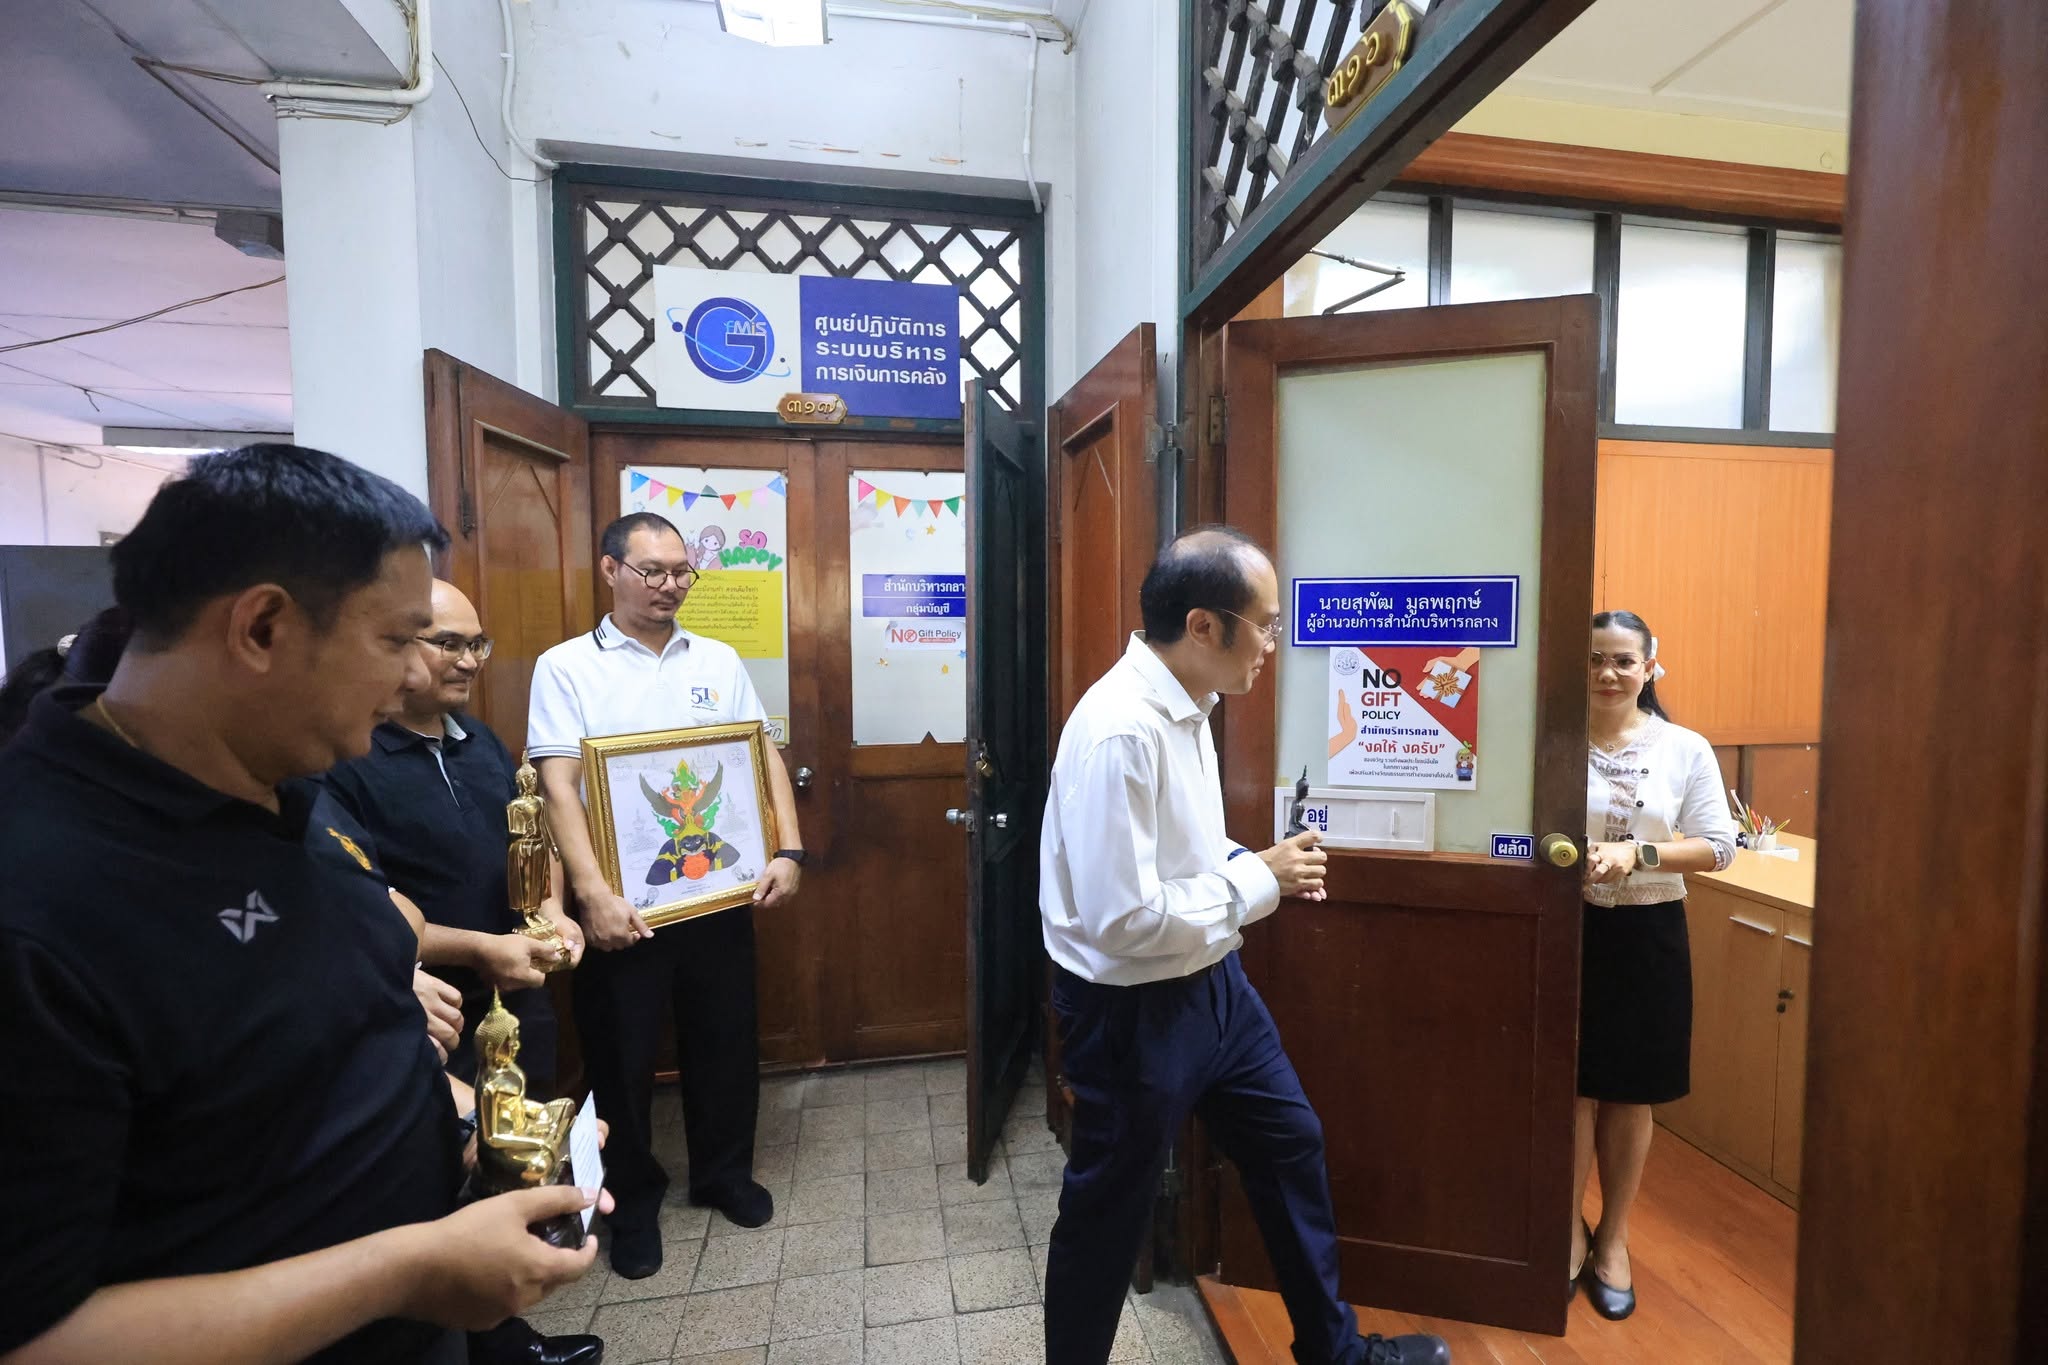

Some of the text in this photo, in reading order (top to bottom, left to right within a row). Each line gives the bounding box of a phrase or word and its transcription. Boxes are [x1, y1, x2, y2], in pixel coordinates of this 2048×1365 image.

[815, 313, 946, 337] ศูนย์ปฏิบัติการ
[816, 341, 946, 361] ระบบบริหาร
[816, 364, 947, 385] การเงินการคลัง
[787, 399, 837, 414] ๓๑๗
[739, 529, 767, 549] SO
[718, 546, 783, 571] HAPPY
[884, 578, 966, 592] สำนักบริหารกลา
[906, 602, 950, 616] กลุ่มบัญชี
[1319, 589, 1482, 615] นายสุพัฒ มูลพฤกษ์
[1306, 613, 1498, 633] ผู้อำนวยการสำนักบริหารกลาง
[918, 630, 934, 638] Gift
[935, 630, 962, 639] Policy
[1362, 668, 1402, 689] NO
[1361, 691, 1402, 707] GIFT
[1362, 710, 1401, 720] POLICY
[1360, 725, 1439, 736] สำนักบริหารกลาง
[1306, 804, 1328, 832] อยู่
[1498, 839, 1528, 855] ผลัก
